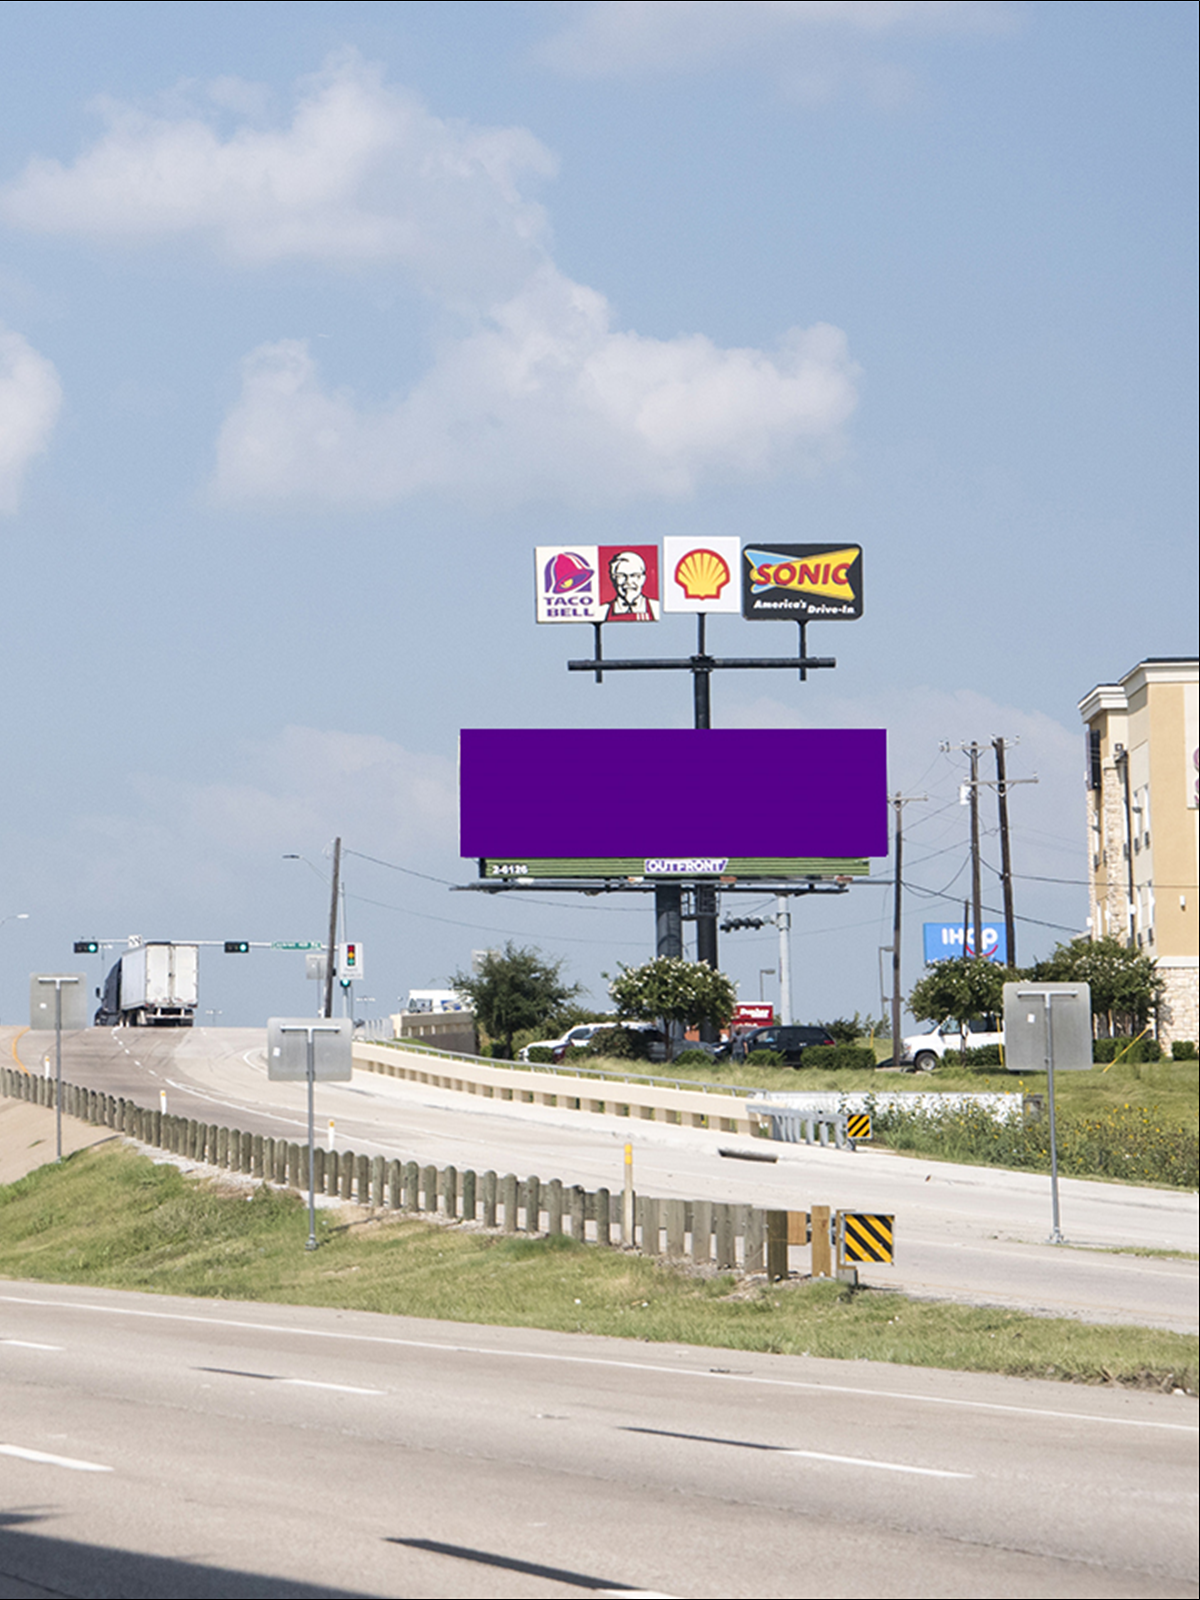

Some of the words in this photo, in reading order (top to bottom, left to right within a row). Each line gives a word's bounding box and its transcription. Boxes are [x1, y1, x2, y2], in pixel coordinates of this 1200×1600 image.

[756, 563, 851, 586] SONIC
[543, 596, 594, 606] TACO
[753, 599, 807, 609] America's
[807, 604, 855, 614] Drive-In
[547, 608, 594, 617] BELL
[648, 860, 724, 872] OUTFRONT
